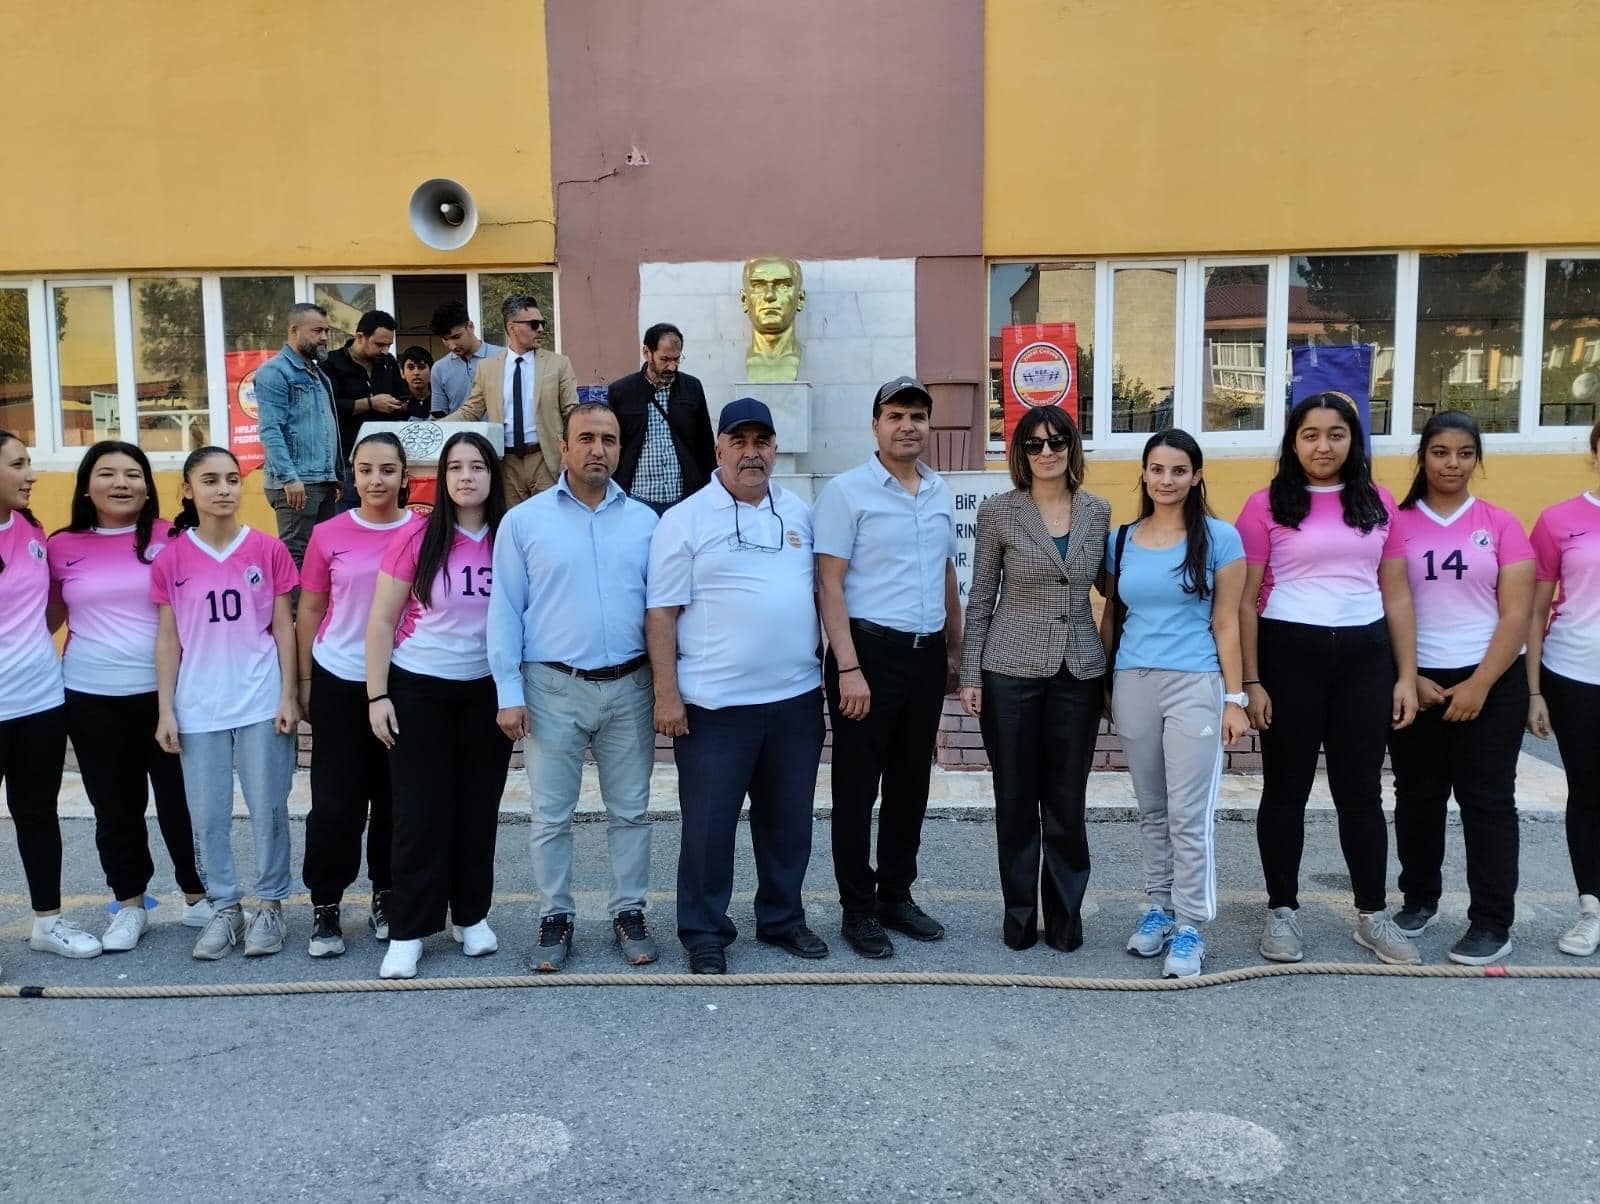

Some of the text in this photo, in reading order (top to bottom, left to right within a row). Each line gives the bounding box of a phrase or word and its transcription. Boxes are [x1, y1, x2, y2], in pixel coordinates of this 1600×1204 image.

[461, 565, 493, 598] 13
[1423, 549, 1469, 581] 14
[205, 589, 242, 623] 10
